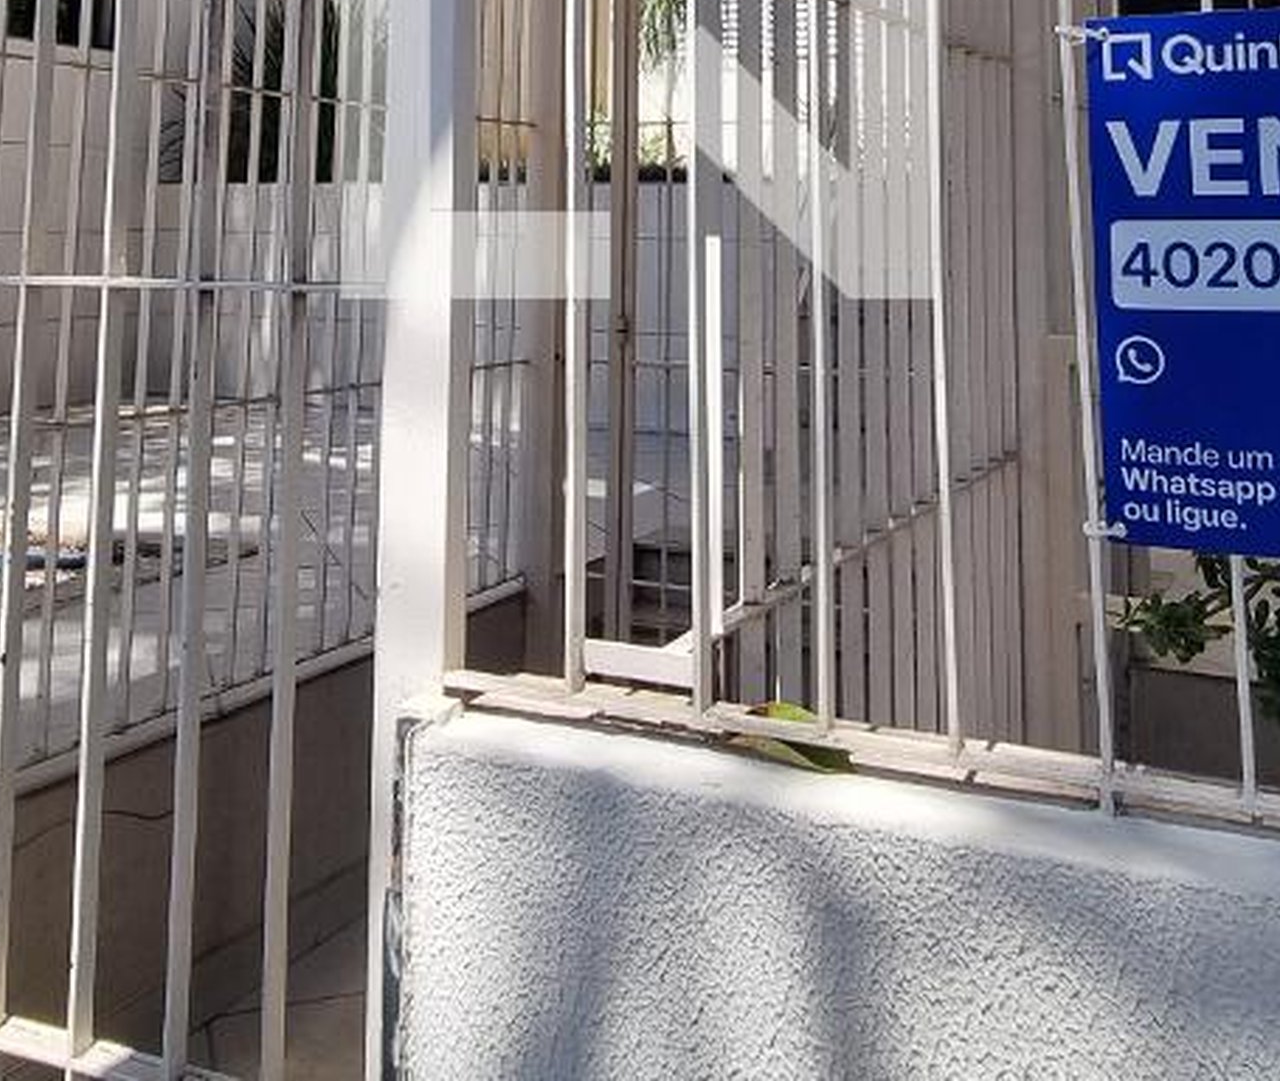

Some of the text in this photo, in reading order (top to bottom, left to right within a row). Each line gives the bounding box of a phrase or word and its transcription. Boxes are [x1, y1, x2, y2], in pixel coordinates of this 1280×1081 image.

[1121, 438, 1274, 470] Mande um
[1121, 467, 1276, 506] Whatsapp
[1124, 498, 1247, 531] ou ligue.
